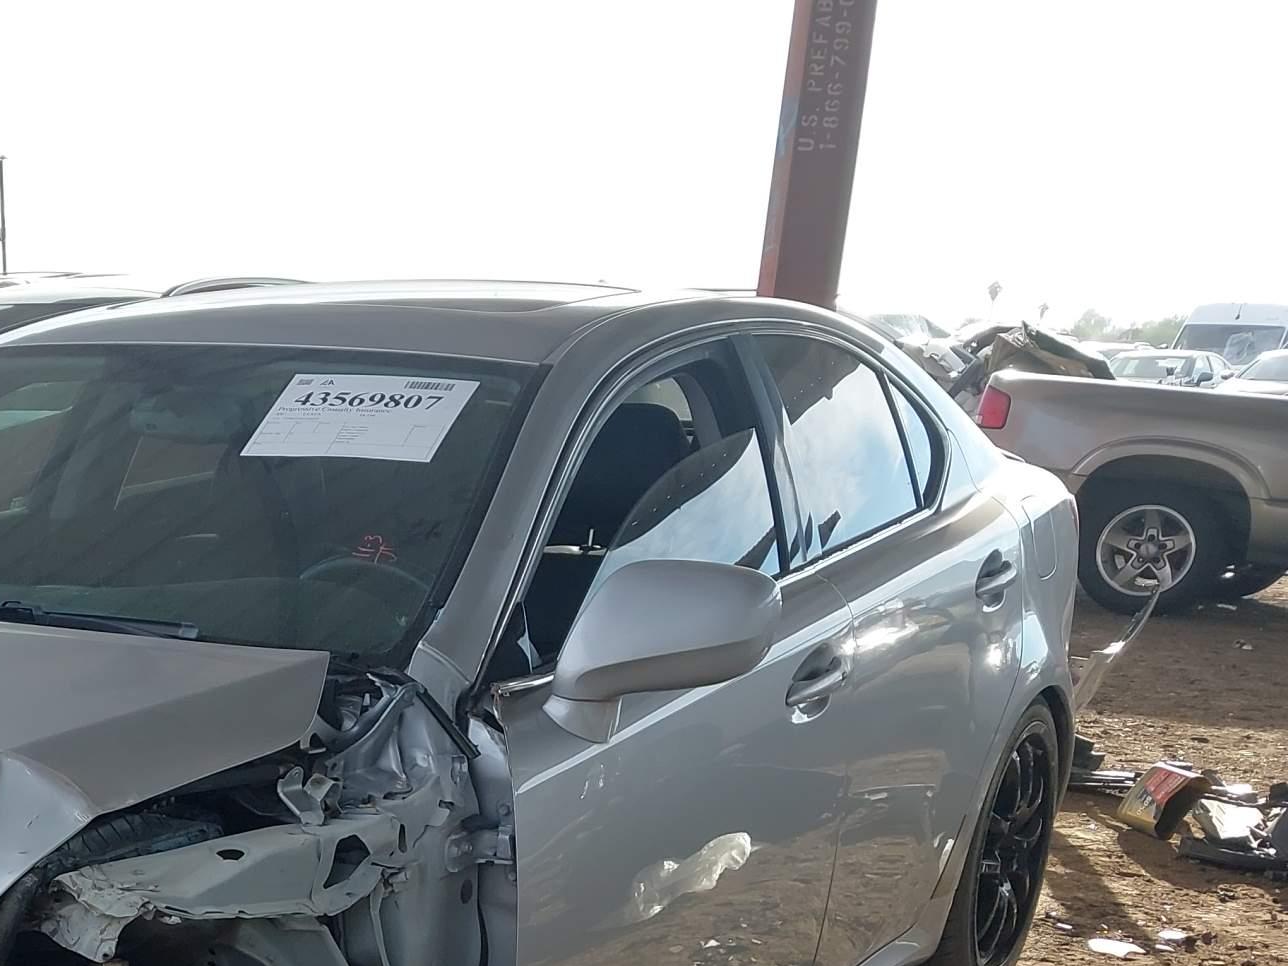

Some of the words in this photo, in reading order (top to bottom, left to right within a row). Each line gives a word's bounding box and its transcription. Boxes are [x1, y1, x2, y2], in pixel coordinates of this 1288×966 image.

[807, 0, 833, 92] PREFAB
[797, 107, 820, 152] U.S.
[294, 391, 445, 410] 43569807
